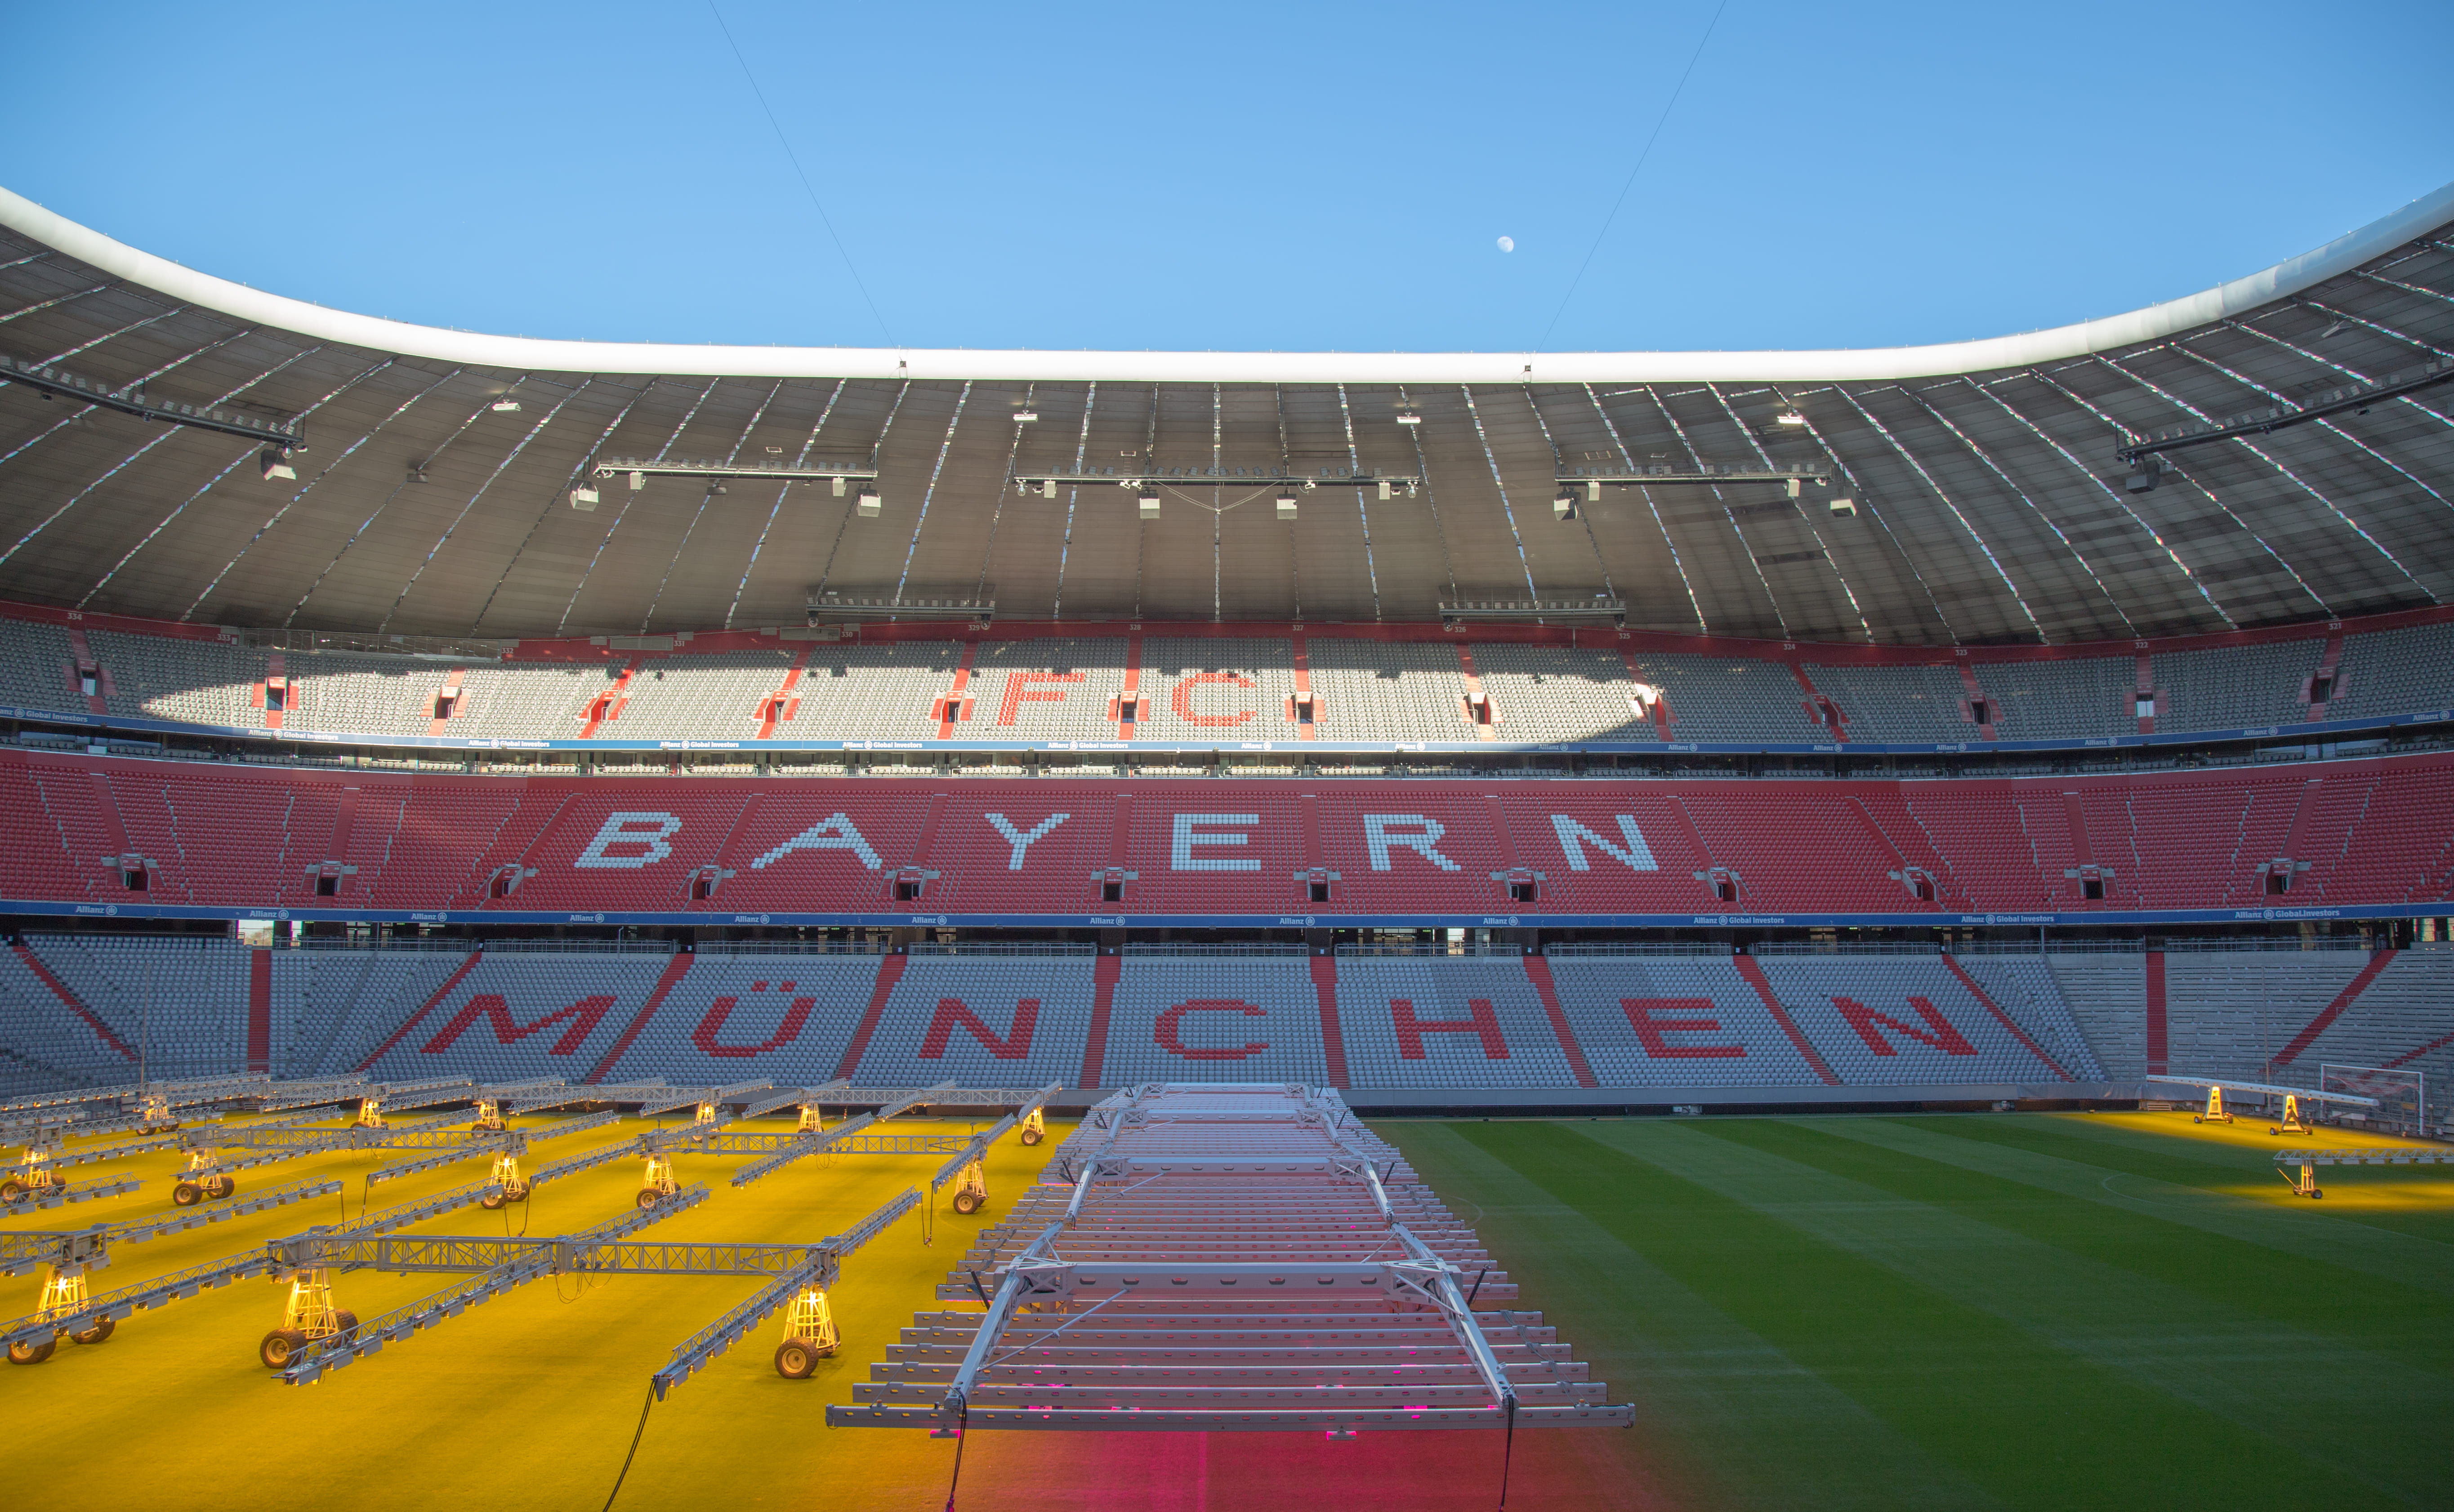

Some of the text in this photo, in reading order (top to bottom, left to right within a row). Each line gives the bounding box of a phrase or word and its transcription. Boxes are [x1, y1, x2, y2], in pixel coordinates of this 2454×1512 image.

[26, 710, 51, 719] Global
[52, 713, 88, 722] Investors
[998, 673, 1257, 727] FC
[574, 812, 1658, 871] BAYERN
[76, 905, 104, 914] Allianz
[421, 981, 1978, 1060] MÜNCHEN
